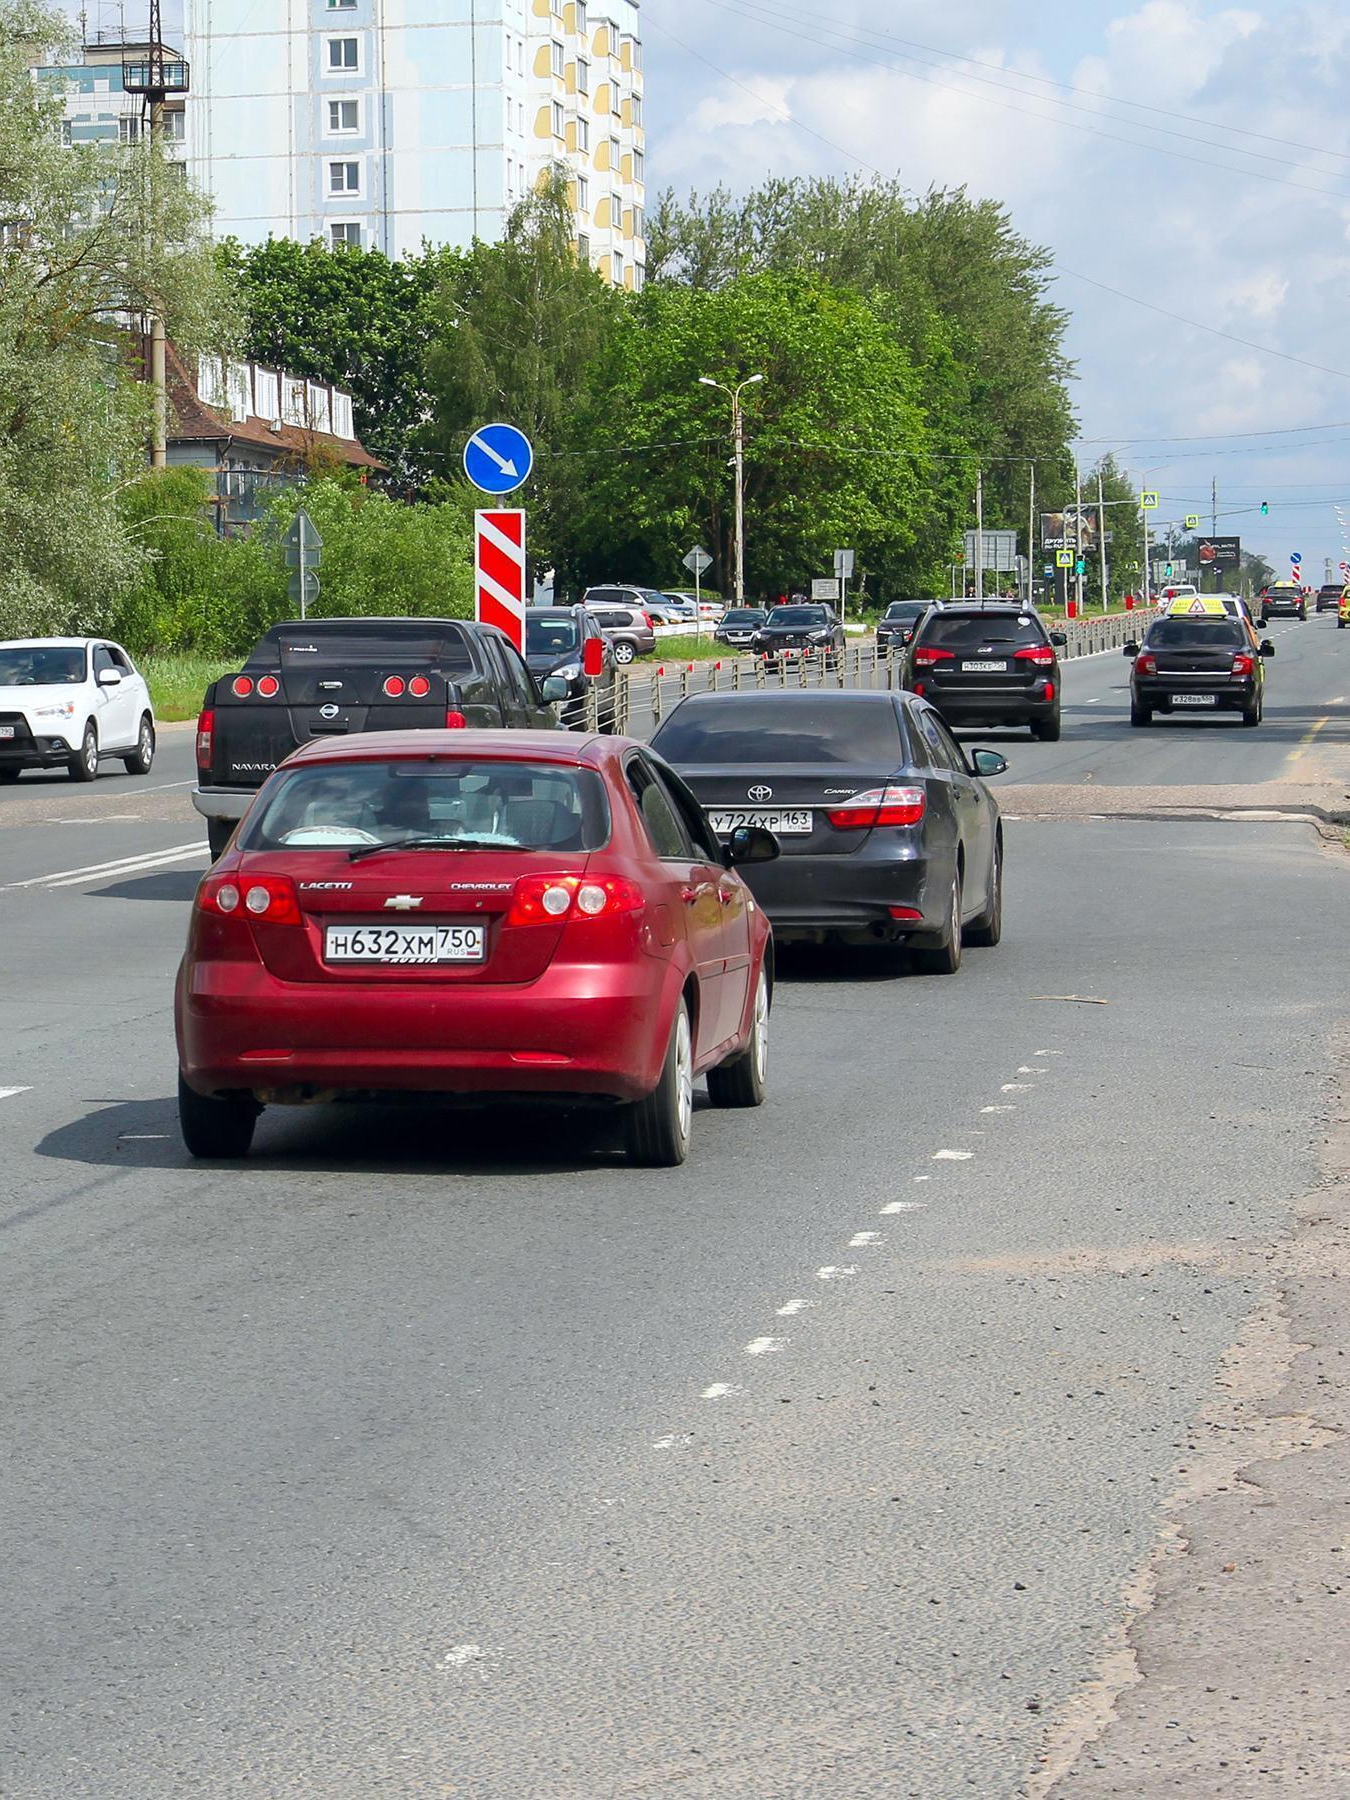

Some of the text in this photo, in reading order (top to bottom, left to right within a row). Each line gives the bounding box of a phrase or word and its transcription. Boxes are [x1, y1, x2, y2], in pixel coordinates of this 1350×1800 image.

[232, 763, 277, 771] NAVARA
[783, 812, 808, 825] 163
[300, 882, 353, 890] LACETTI
[335, 929, 477, 955] Н632ХМ 750
[447, 948, 465, 956] RUS
